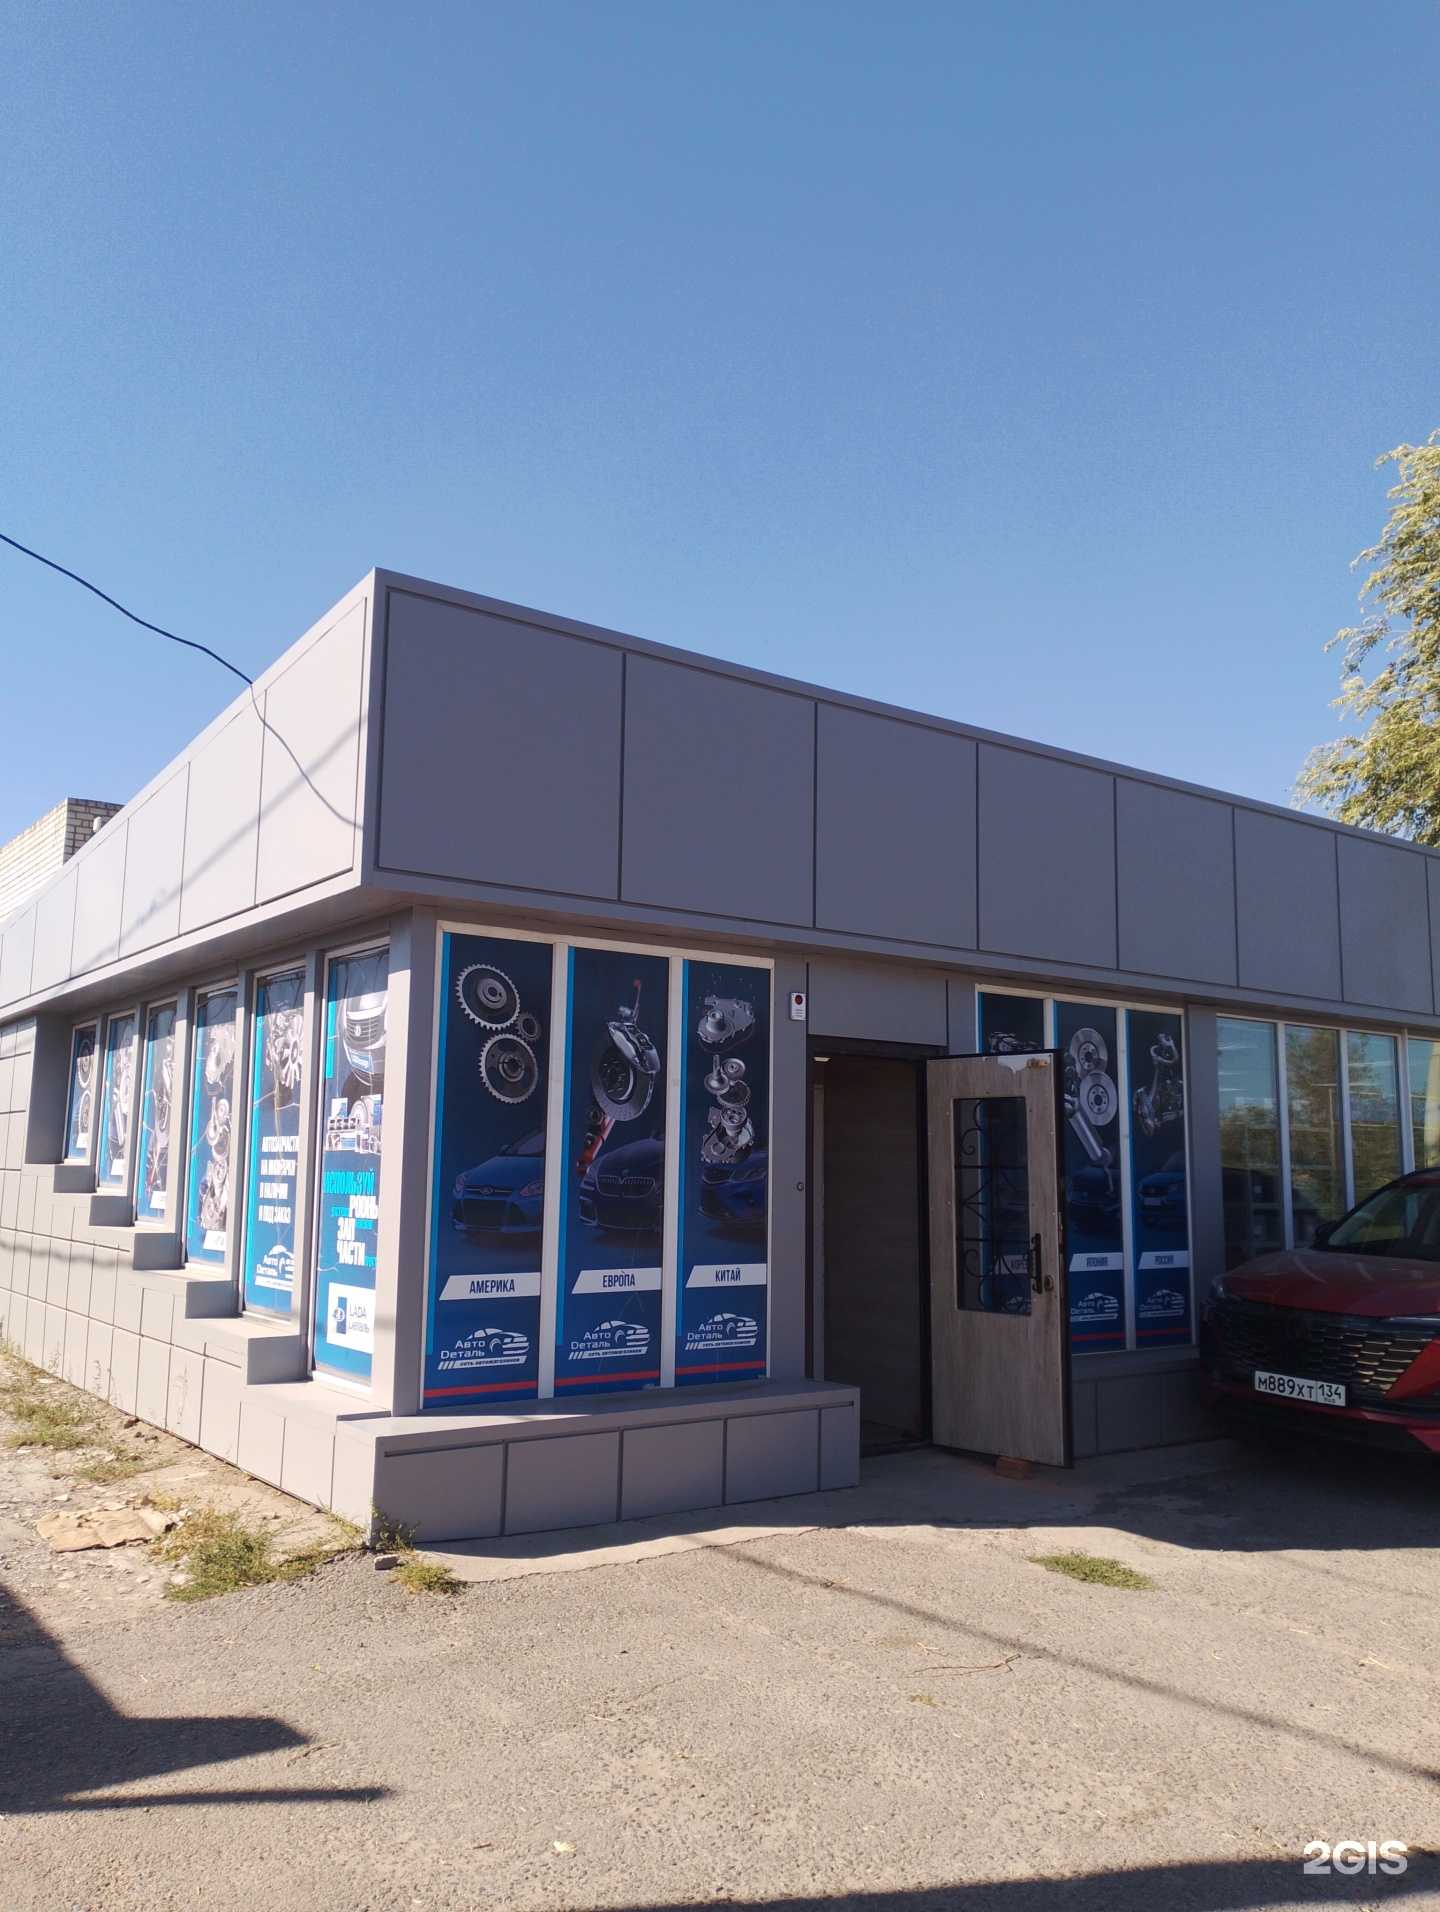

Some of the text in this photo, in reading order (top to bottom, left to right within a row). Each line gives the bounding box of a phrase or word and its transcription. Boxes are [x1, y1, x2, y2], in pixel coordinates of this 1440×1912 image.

[336, 1240, 366, 1265] ЧАСТИ
[602, 1272, 635, 1288] ЕВРОПА
[715, 1267, 741, 1282] КИТАЙ
[469, 1279, 515, 1294] АМЕРИКА
[583, 1331, 612, 1340] Авто
[455, 1340, 486, 1349] Авто
[1318, 1383, 1342, 1400] 134
